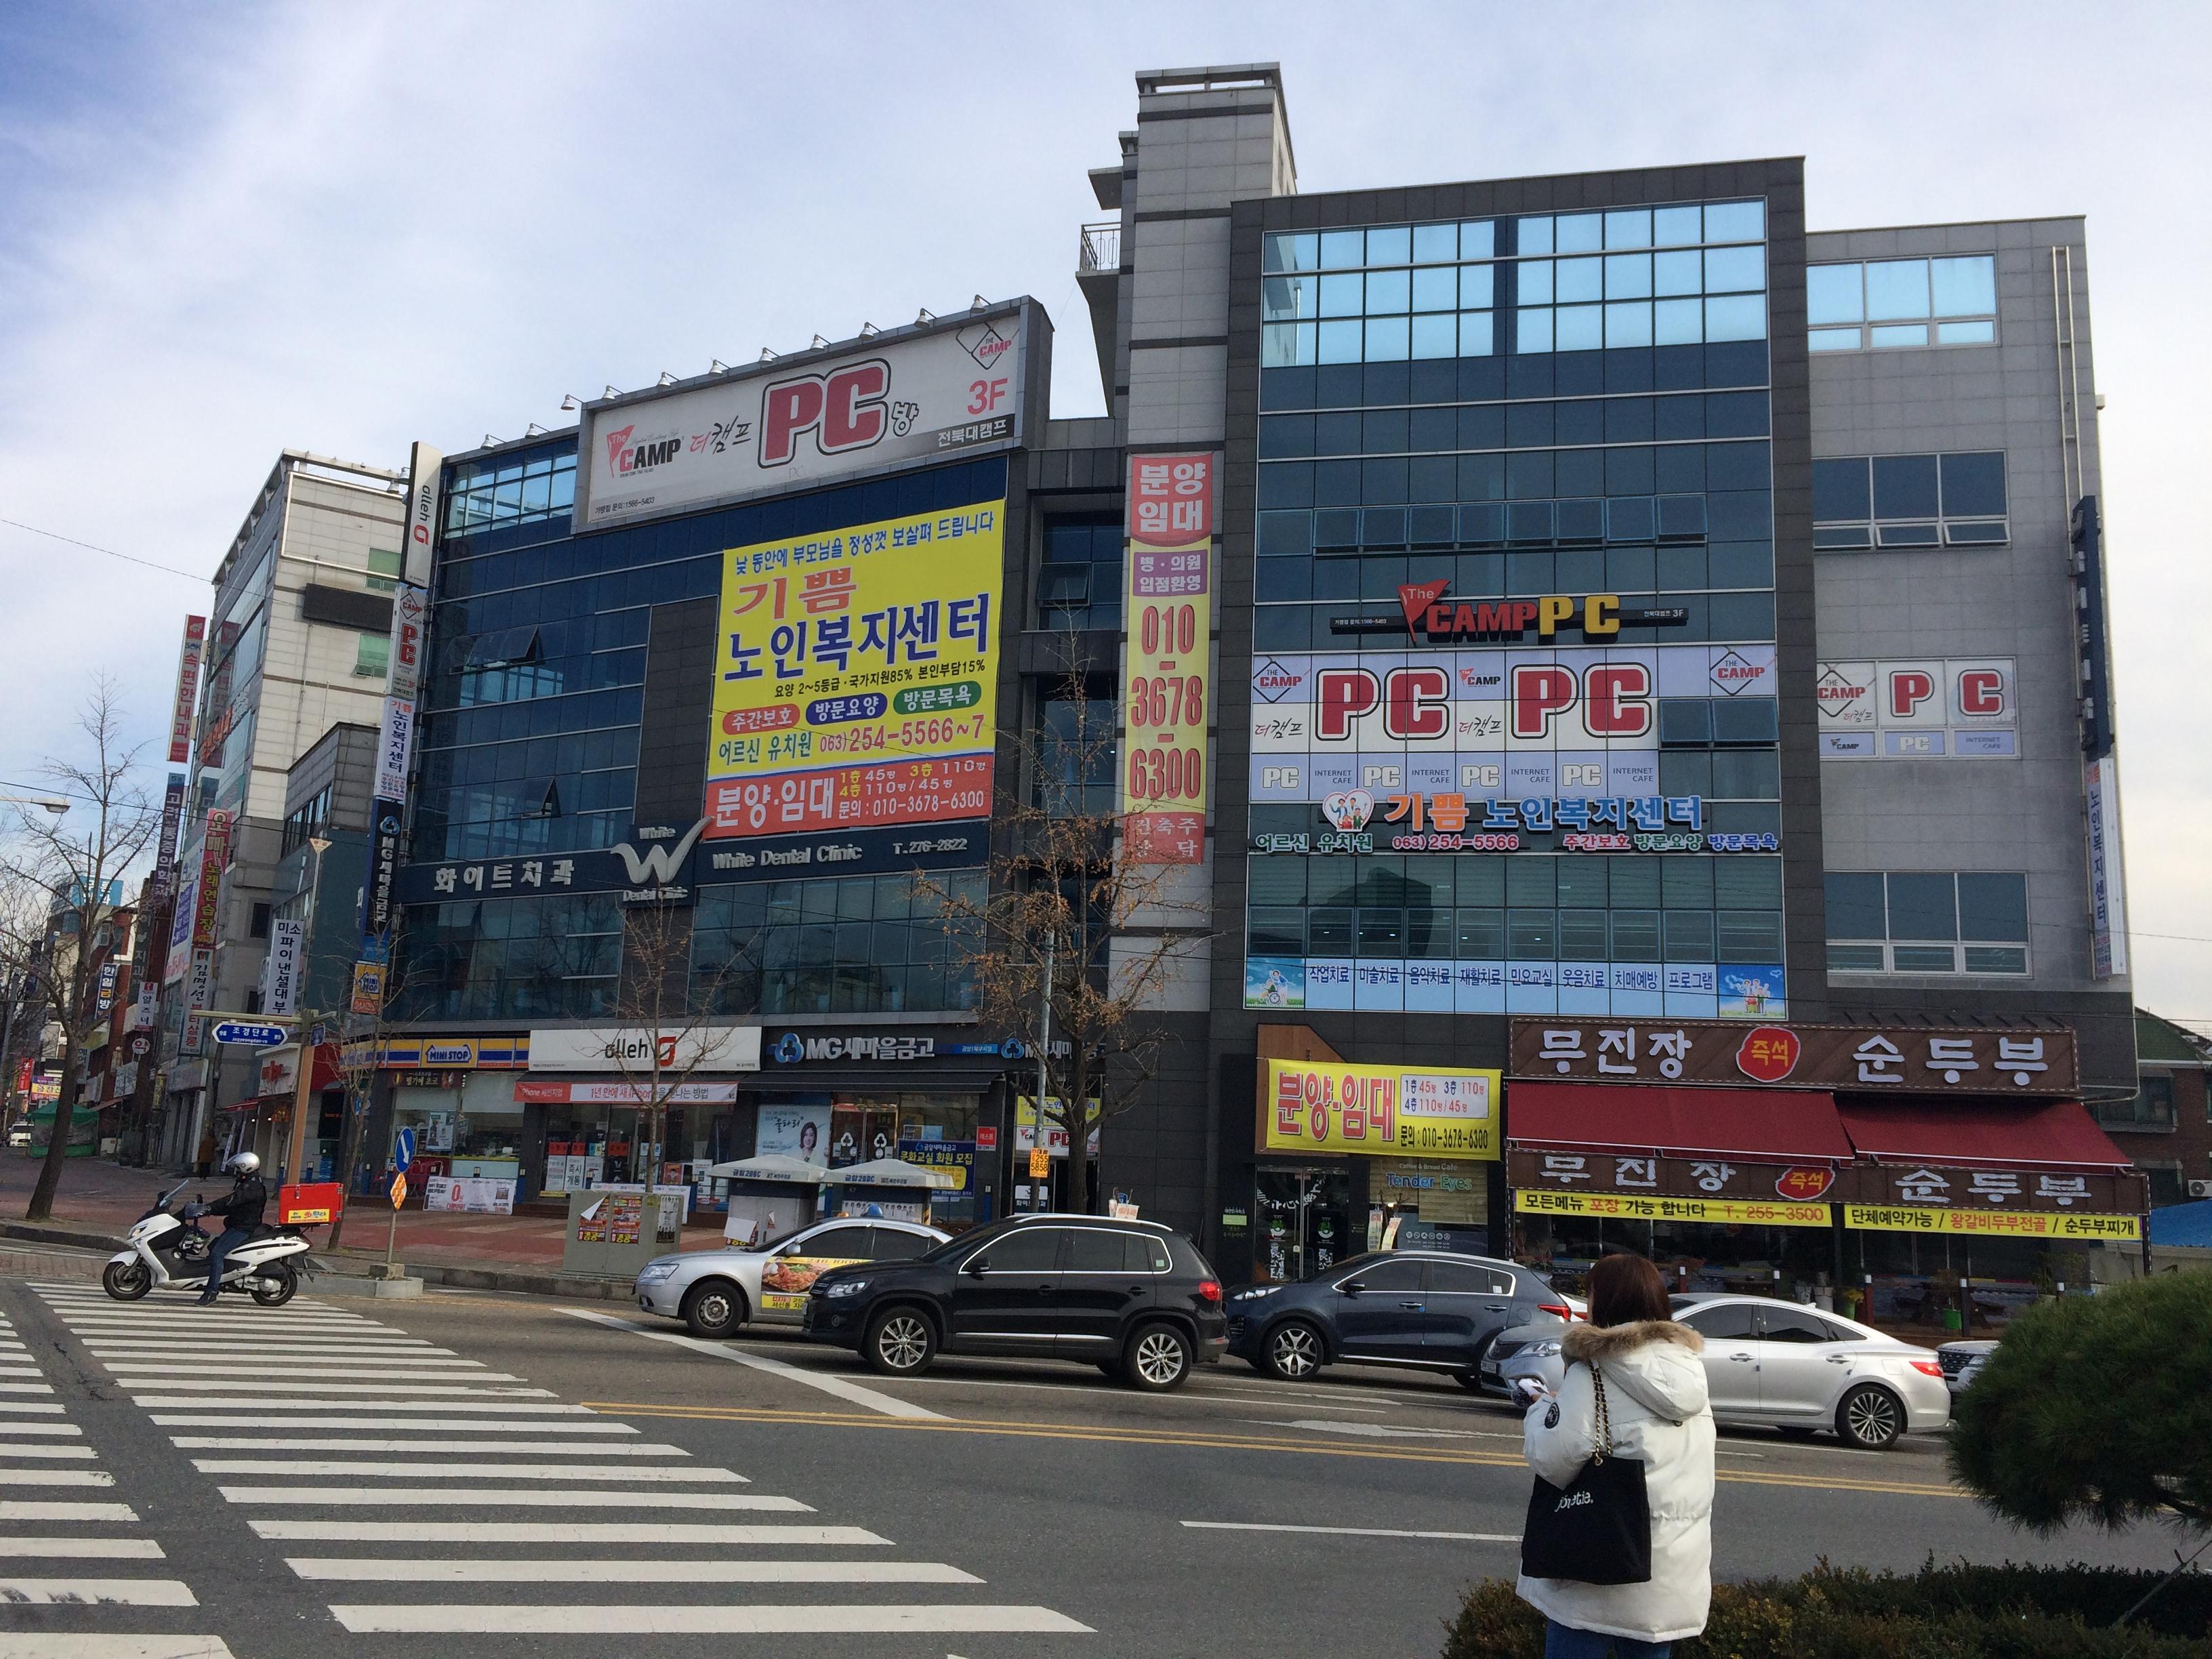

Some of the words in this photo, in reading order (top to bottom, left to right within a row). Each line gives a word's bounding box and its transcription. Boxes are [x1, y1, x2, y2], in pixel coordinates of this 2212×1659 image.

[979, 340, 1012, 356] CAMP
[967, 377, 1008, 415] 3F
[611, 434, 627, 443] The
[938, 419, 1007, 448] 전북대캠프
[619, 438, 682, 472] CAMP
[1139, 462, 1206, 495] 분양
[419, 485, 432, 523] olleh
[1138, 499, 1204, 533] 임대
[736, 555, 748, 575] 낮
[752, 549, 788, 573] 동안에
[793, 537, 843, 566] 부모님을
[849, 530, 888, 557] 정성껏
[892, 523, 932, 548] 보살펴
[937, 511, 995, 540] 드립니다
[403, 601, 423, 613] CAMP
[733, 567, 857, 620] 기쁨
[1408, 588, 1435, 599] The
[1426, 602, 1538, 634] CAMP
[1673, 609, 1684, 617] 3F
[723, 592, 991, 682] 노인복지센터
[1141, 604, 1195, 655] 010
[399, 623, 418, 665] PC
[774, 682, 795, 698] 요양
[918, 659, 986, 680] 본인부담15%
[1259, 676, 1302, 687] CAMP
[1467, 676, 1500, 685] CAMP
[1718, 666, 1765, 678] CAMP
[174, 653, 199, 739] 속편한내과
[1130, 676, 1202, 727] 3678
[1315, 666, 1450, 741] PC
[1511, 662, 1653, 739] PC
[1818, 687, 1866, 699] CAMP
[731, 707, 793, 731] 주간보호
[815, 695, 880, 722] 방문요양
[902, 684, 972, 712] 방문목욕
[388, 710, 409, 773] 노인복지센터
[718, 737, 761, 766] 어르신
[767, 731, 813, 762] 유치원
[1900, 737, 1930, 752] PC
[909, 763, 933, 778] 3층
[1129, 747, 1201, 800] 6300
[1262, 766, 1300, 788] PC
[1363, 765, 1400, 787] PC
[1461, 765, 1500, 787] PC
[1561, 764, 1602, 787] PC
[1384, 792, 1469, 832] 기쁨
[1482, 794, 1702, 832] 노인복지센터
[639, 827, 676, 839] White
[1256, 834, 1309, 853] 어르신
[1317, 833, 1373, 853] 유치원
[1563, 834, 1631, 851] 주간보호
[1634, 834, 1703, 851] 방문요양
[1708, 834, 1778, 851] 방문목욕
[712, 851, 756, 870] White
[760, 846, 811, 867] Dental
[817, 842, 863, 863] Clinic
[434, 863, 575, 894] 화이트치과
[199, 862, 222, 931] 노래연습장
[623, 888, 657, 901] Dental
[99, 966, 115, 1009] 한일금방
[1309, 965, 1350, 984] 작업치료
[1359, 966, 1399, 985] 미술치료
[1409, 967, 1451, 986] 음악치료
[1459, 968, 1502, 987] 재활치료
[1510, 968, 1553, 987] 민요교실
[1561, 968, 1605, 988] 웃음치료
[1614, 970, 1658, 989] 치매예방
[1668, 971, 1713, 991] 프로그램
[232, 1027, 269, 1037] 조경단로
[605, 1038, 649, 1059] olleh
[806, 1037, 935, 1061] MG새마을금고
[1539, 1029, 1693, 1080] 무진장
[1750, 1039, 1789, 1068] 즉석
[1853, 1034, 2049, 1086] 순두부
[1443, 1080, 1456, 1095] 3층
[1405, 1097, 1417, 1111] 4층
[569, 1164, 581, 1174] 즉시
[900, 1151, 933, 1164] 문화교실
[936, 1152, 953, 1164] 회원
[955, 1153, 973, 1165] 모집
[1031, 1163, 1048, 1172] 5858
[1036, 1155, 1048, 1163] 255
[1386, 1172, 1435, 1189] Tender
[1440, 1174, 1473, 1192] Eyes
[1540, 1155, 1737, 1191] 무진장
[1789, 1171, 1824, 1191] 즉석
[1895, 1170, 2092, 1206] 순두부
[1525, 1194, 1584, 1212] 모든메뉴
[1589, 1198, 1619, 1213] 포장
[1625, 1200, 1655, 1215] 가능
[1661, 1201, 1706, 1217] 합니다
[1746, 1206, 1824, 1221] 255-3500
[1851, 1208, 1933, 1228] 단체예약가능
[1950, 1212, 2047, 1232] 왕갈비두부전골
[2064, 1218, 2134, 1235] 순두부찌개
